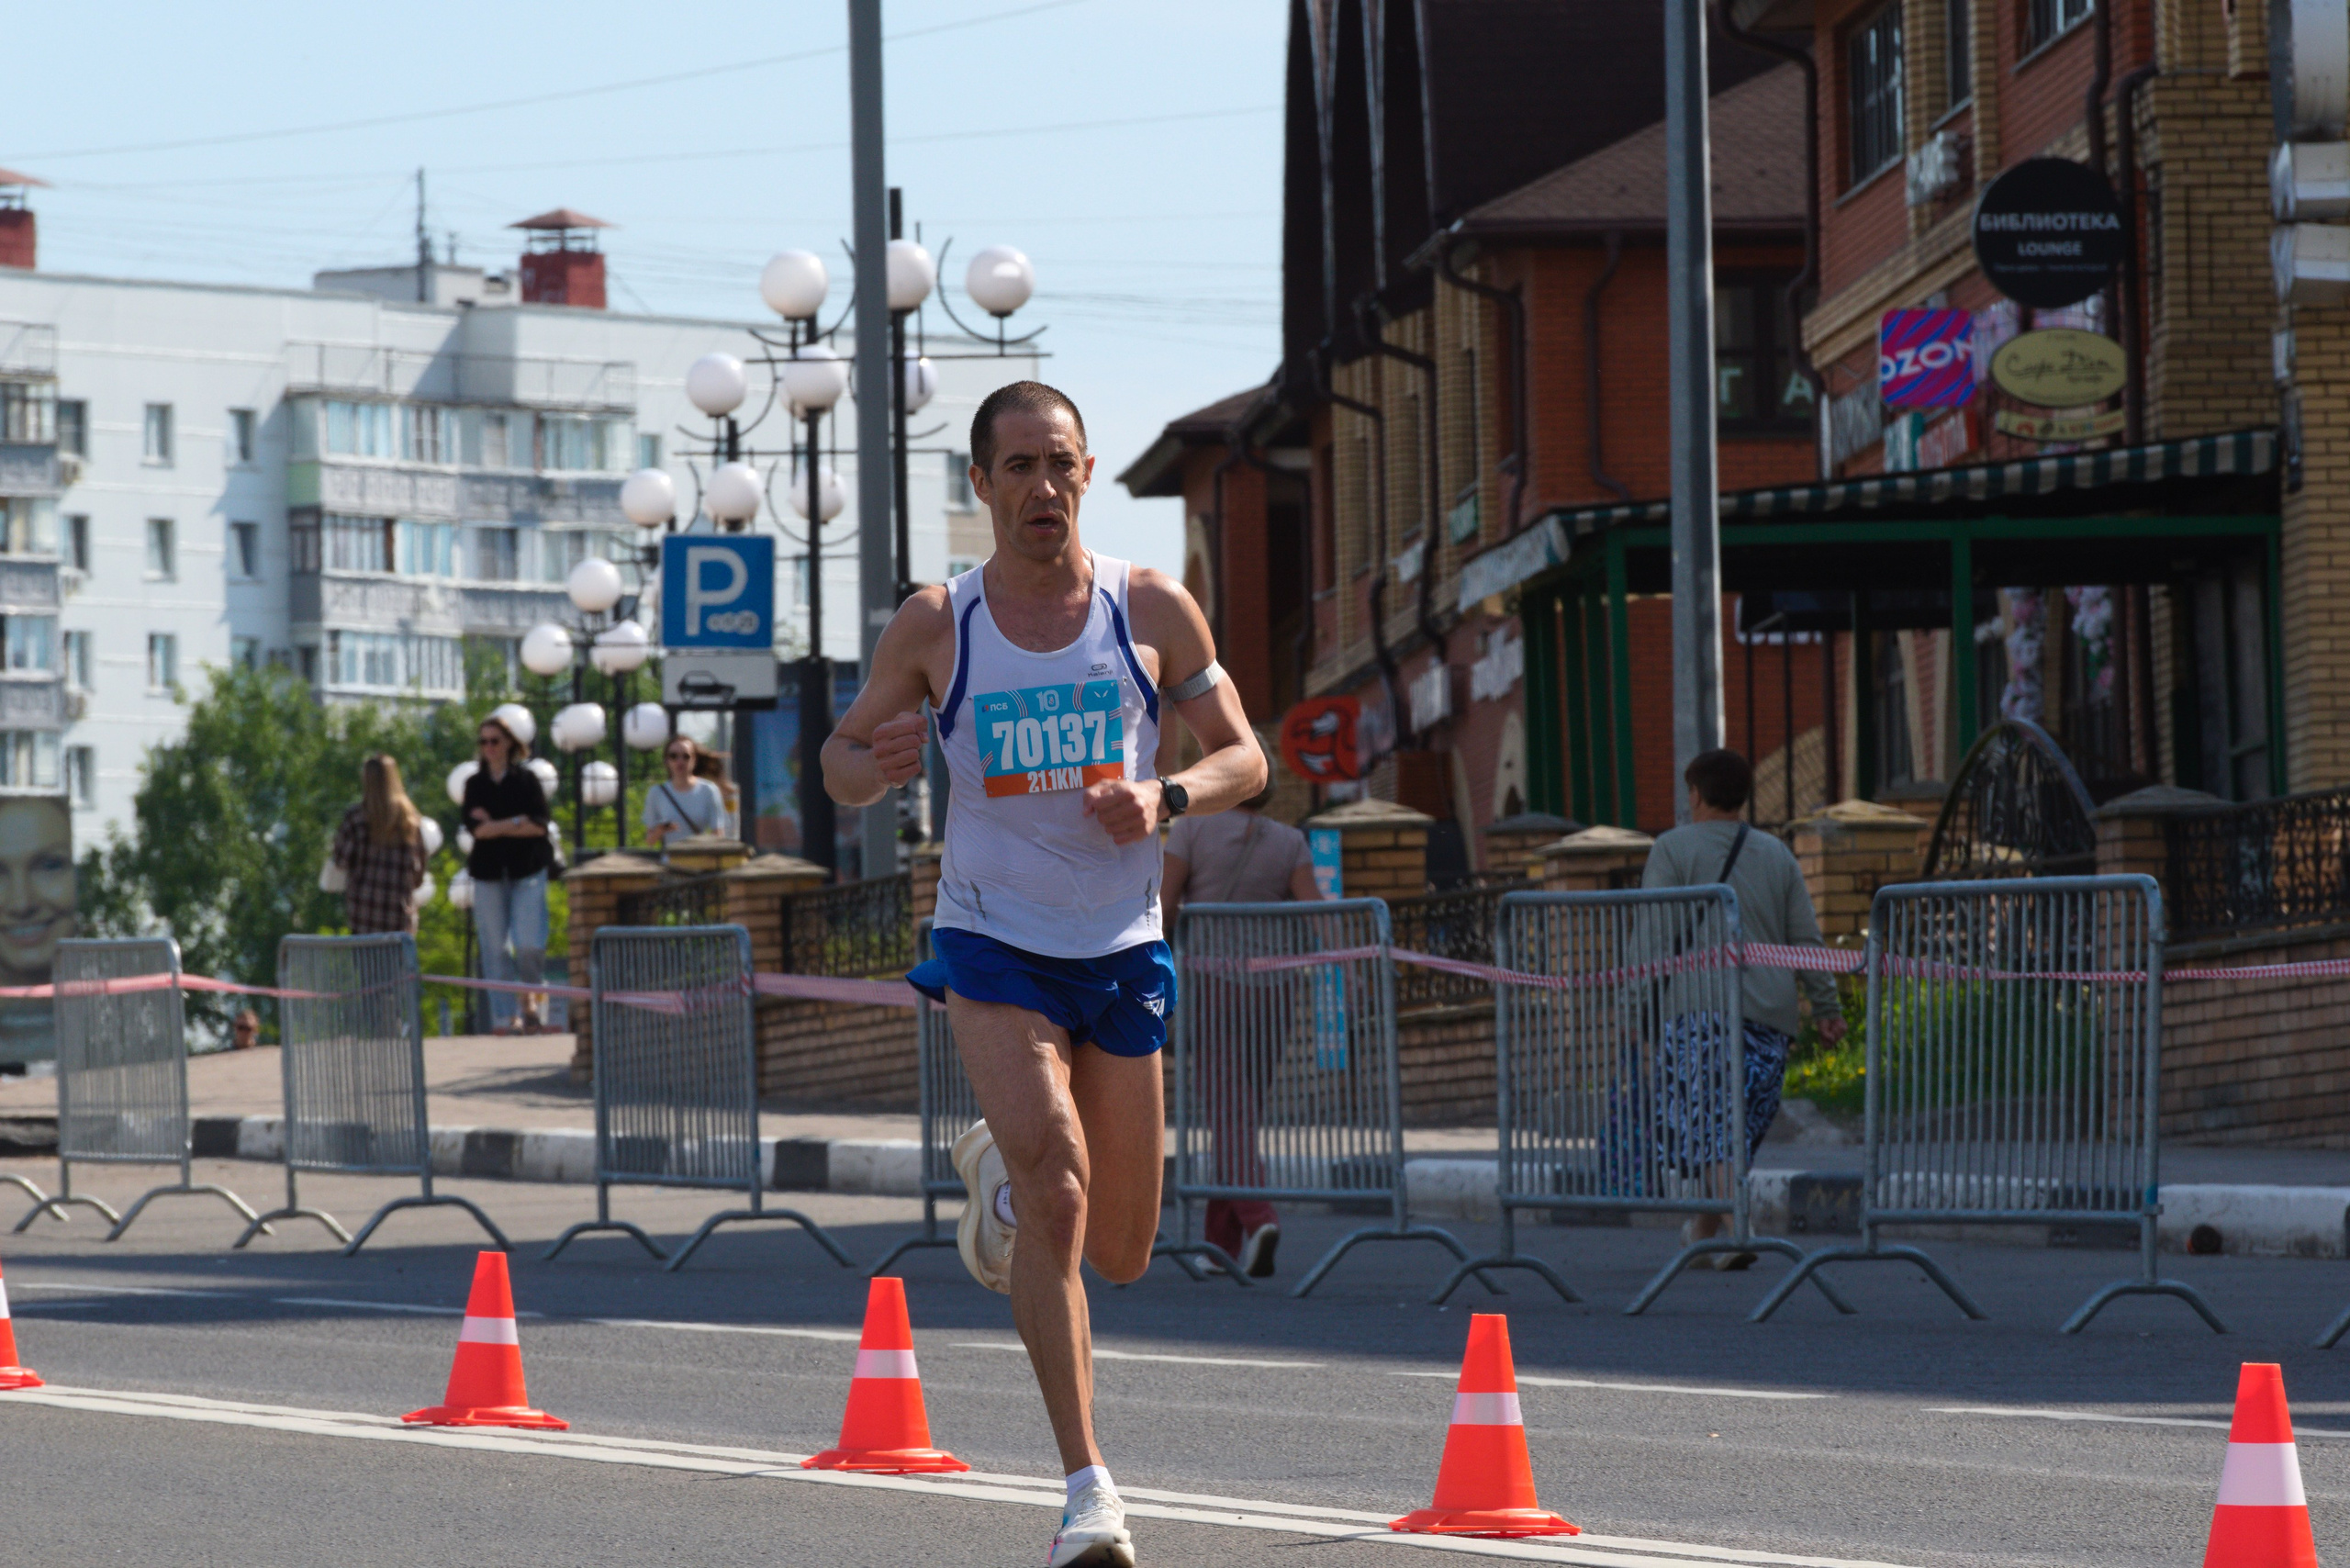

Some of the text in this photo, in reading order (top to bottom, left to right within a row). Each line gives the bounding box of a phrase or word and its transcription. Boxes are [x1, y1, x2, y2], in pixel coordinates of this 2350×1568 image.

[1979, 212, 2121, 231] БИБЛИОТЕКА
[2017, 241, 2084, 257] LOUNGE
[686, 545, 749, 637] P
[990, 702, 1009, 712] ПСБ
[1035, 689, 1060, 712] 10
[991, 710, 1107, 771] 70137
[1027, 767, 1084, 794] 21.1KM
